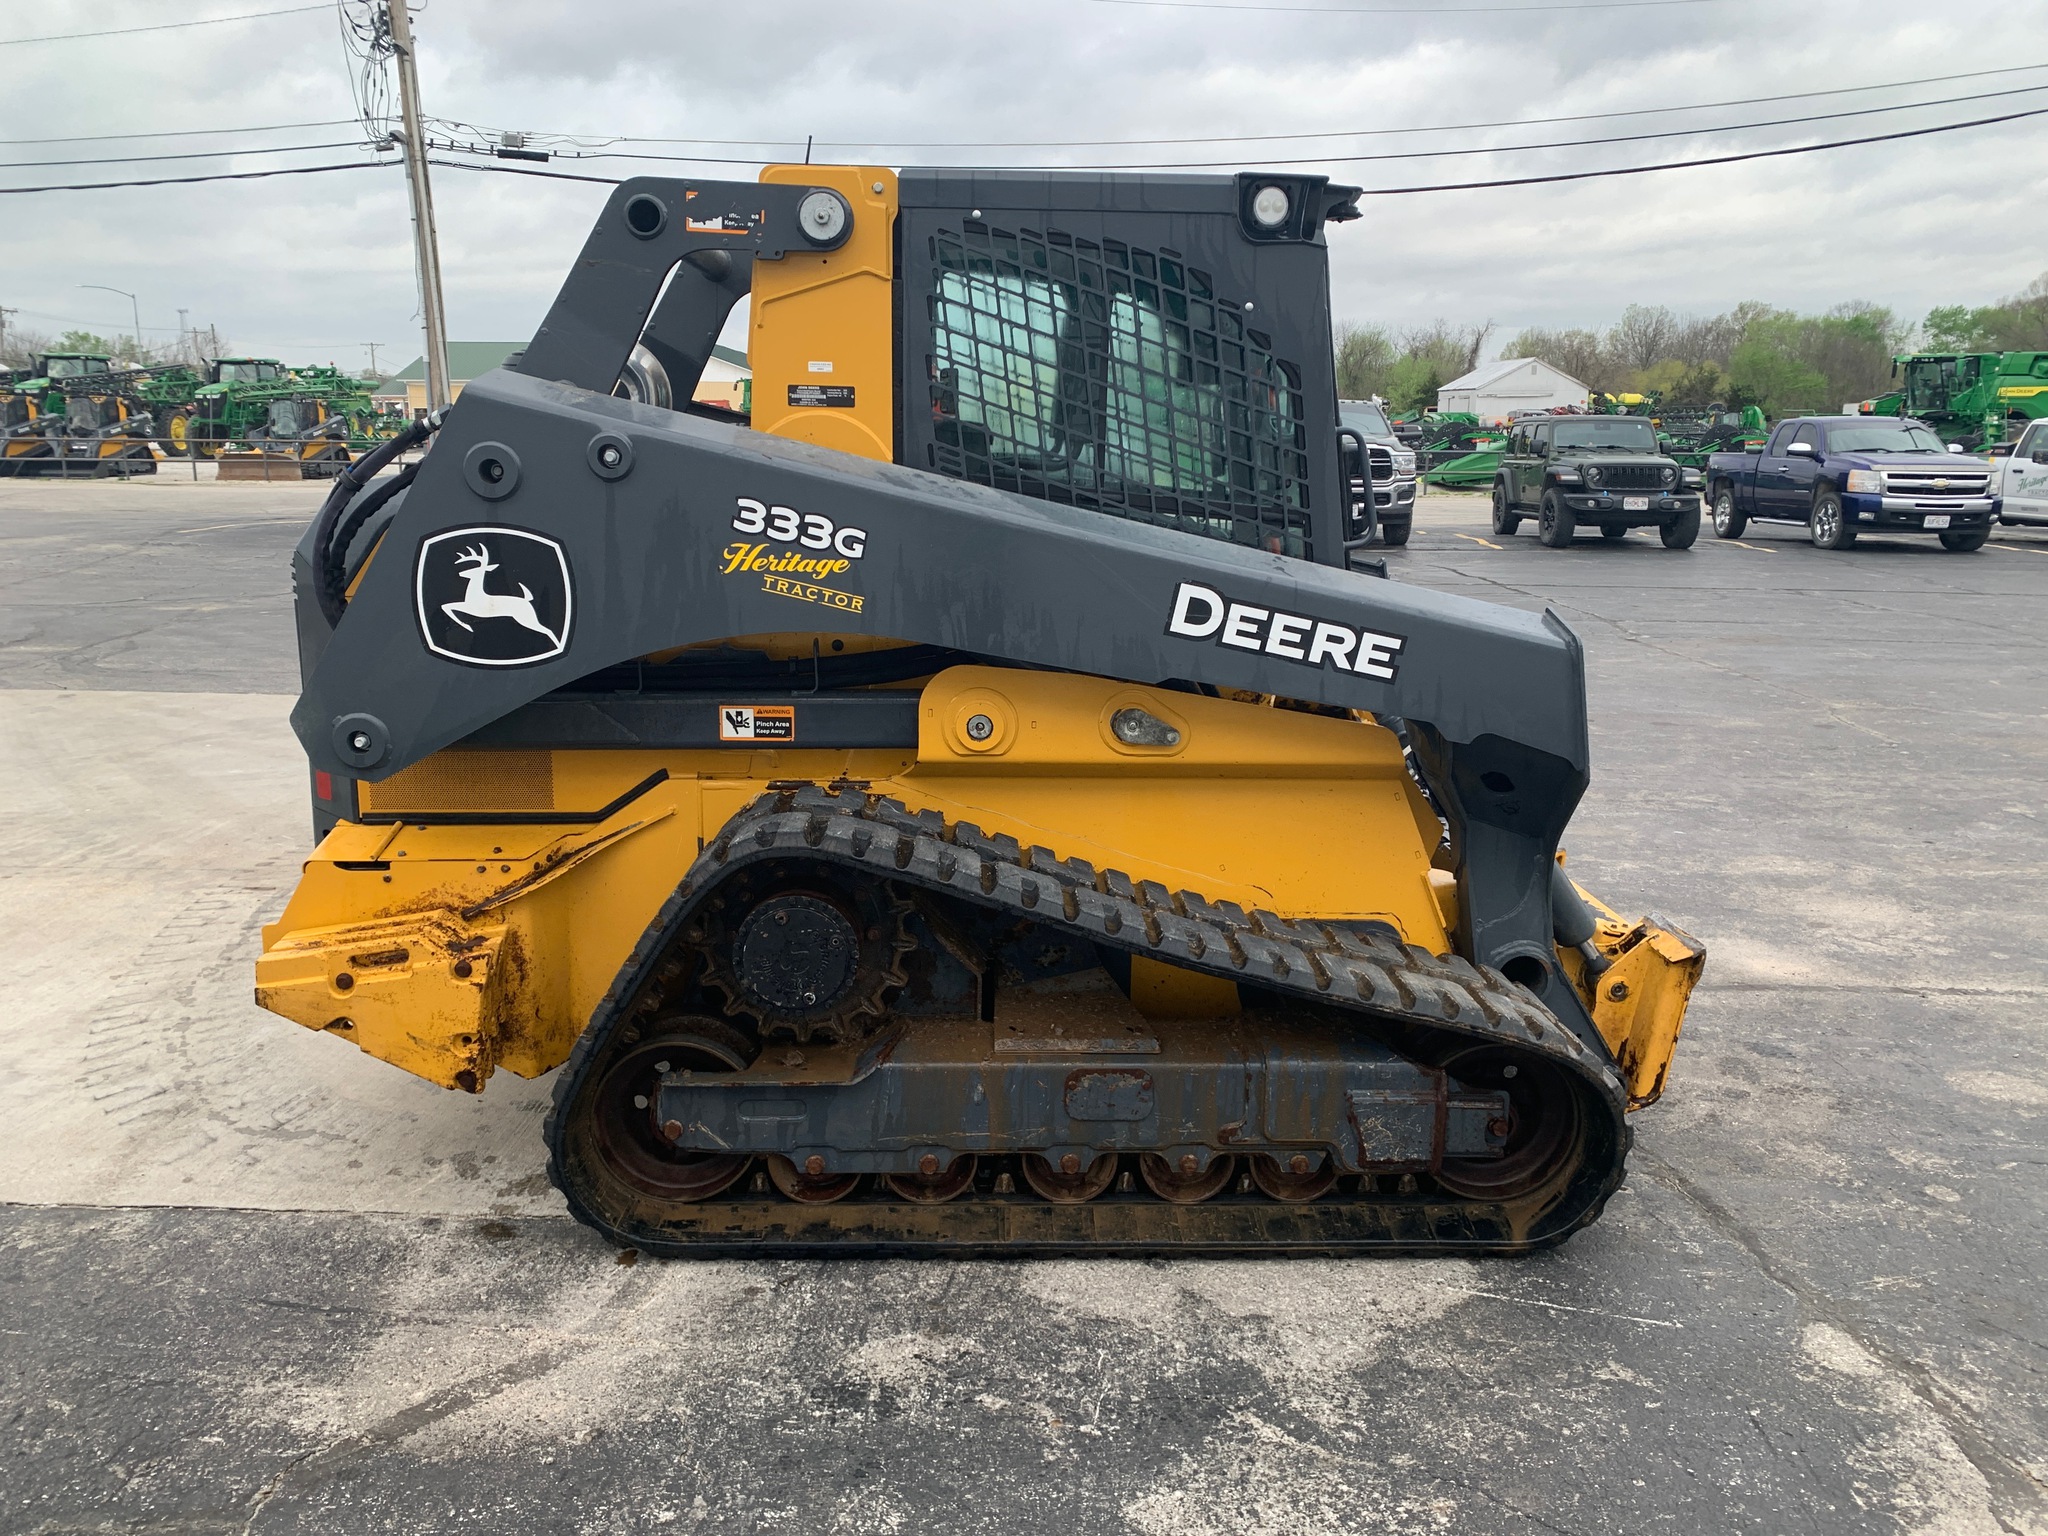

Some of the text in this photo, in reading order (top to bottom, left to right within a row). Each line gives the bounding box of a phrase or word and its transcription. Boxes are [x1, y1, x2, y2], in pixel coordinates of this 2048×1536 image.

[732, 497, 867, 559] 333G
[719, 542, 850, 580] Heritage
[763, 576, 865, 611] TRACTOR
[1168, 582, 1402, 680] DEERE
